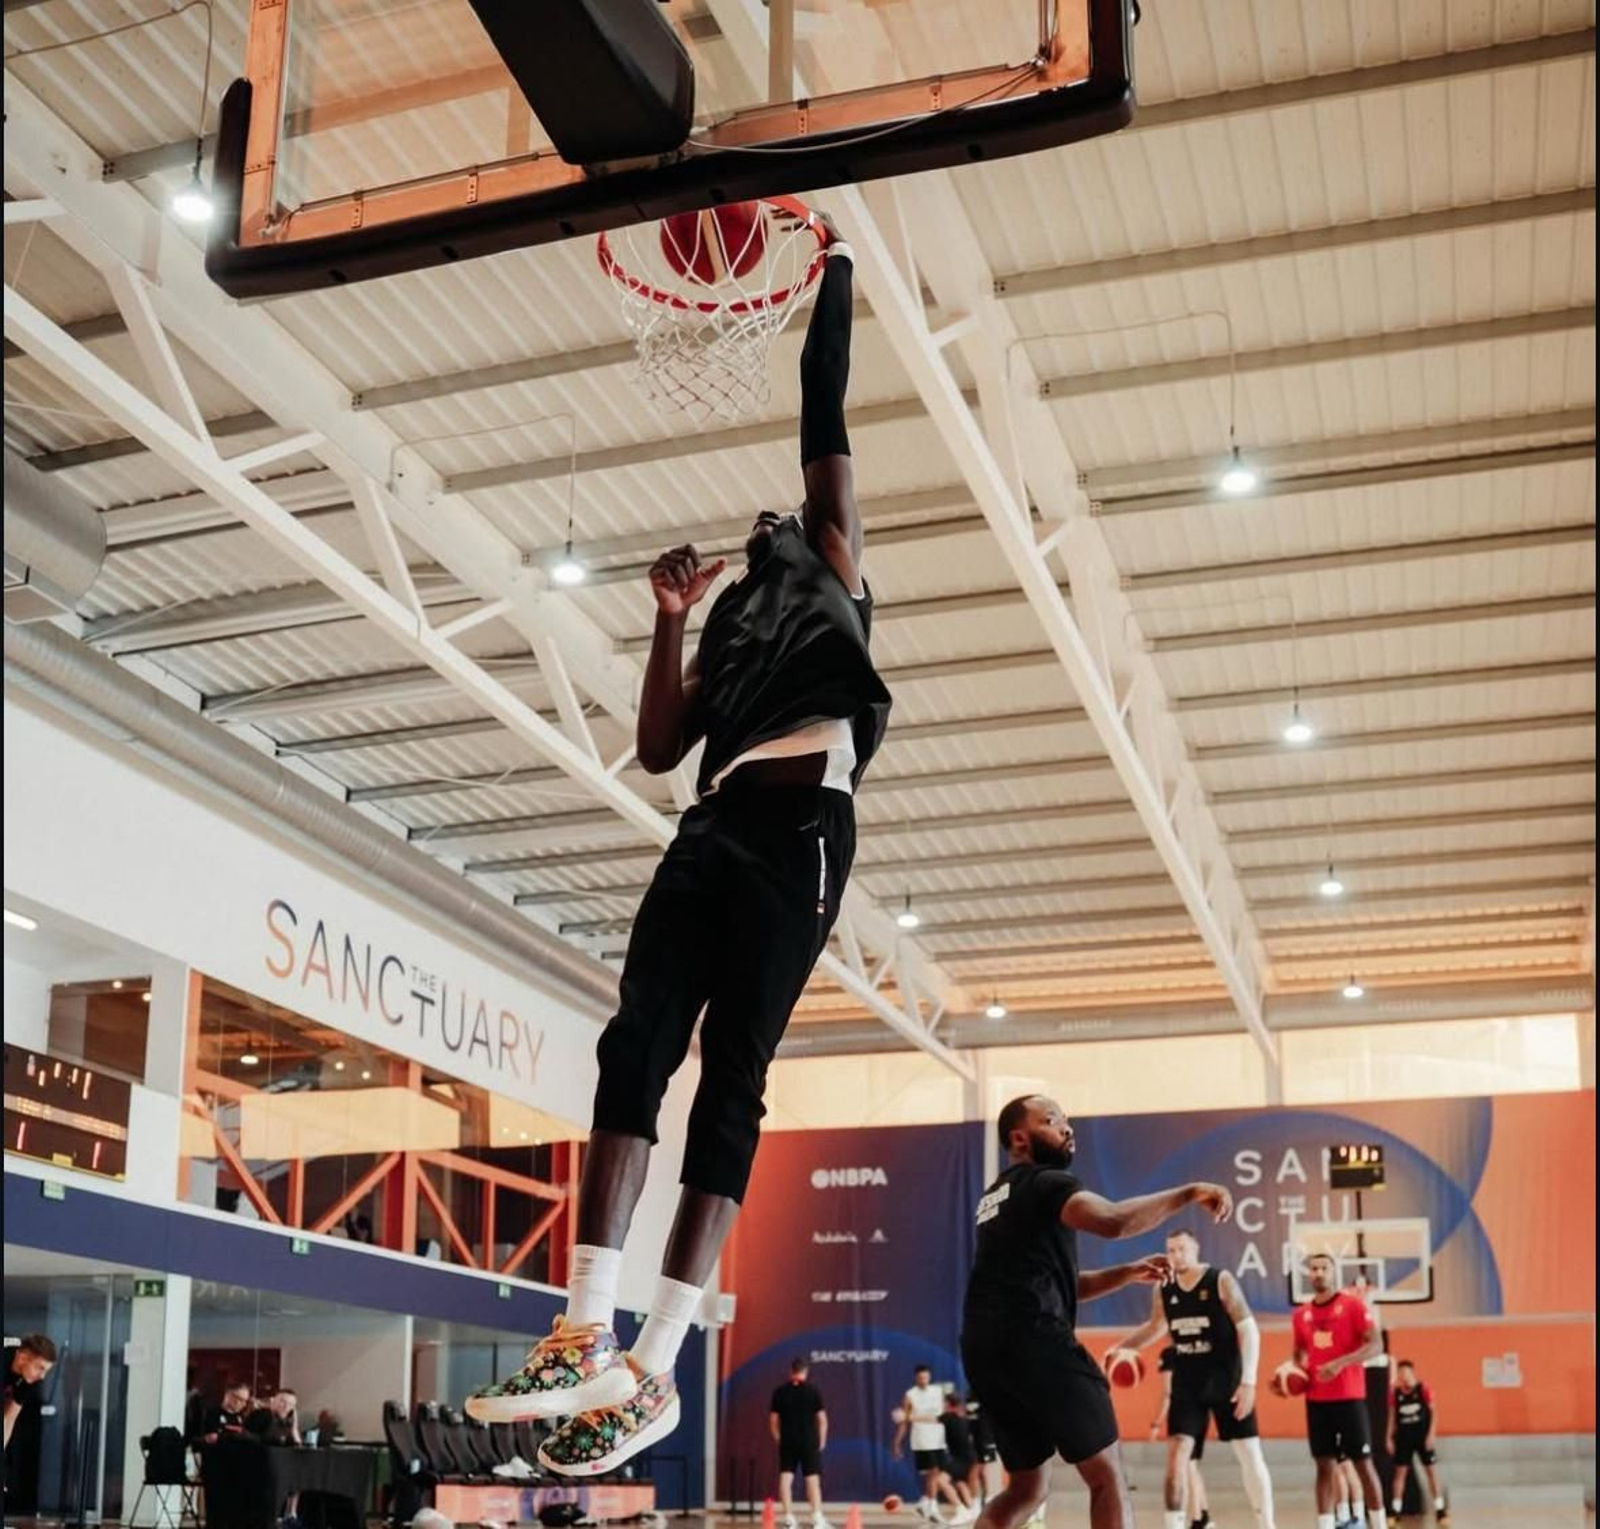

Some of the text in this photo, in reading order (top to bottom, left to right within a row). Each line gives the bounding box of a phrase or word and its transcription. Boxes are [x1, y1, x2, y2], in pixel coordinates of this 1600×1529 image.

[265, 899, 545, 1086] SANCTUARY
[411, 965, 437, 993] THE
[830, 1167, 888, 1188] NBPA
